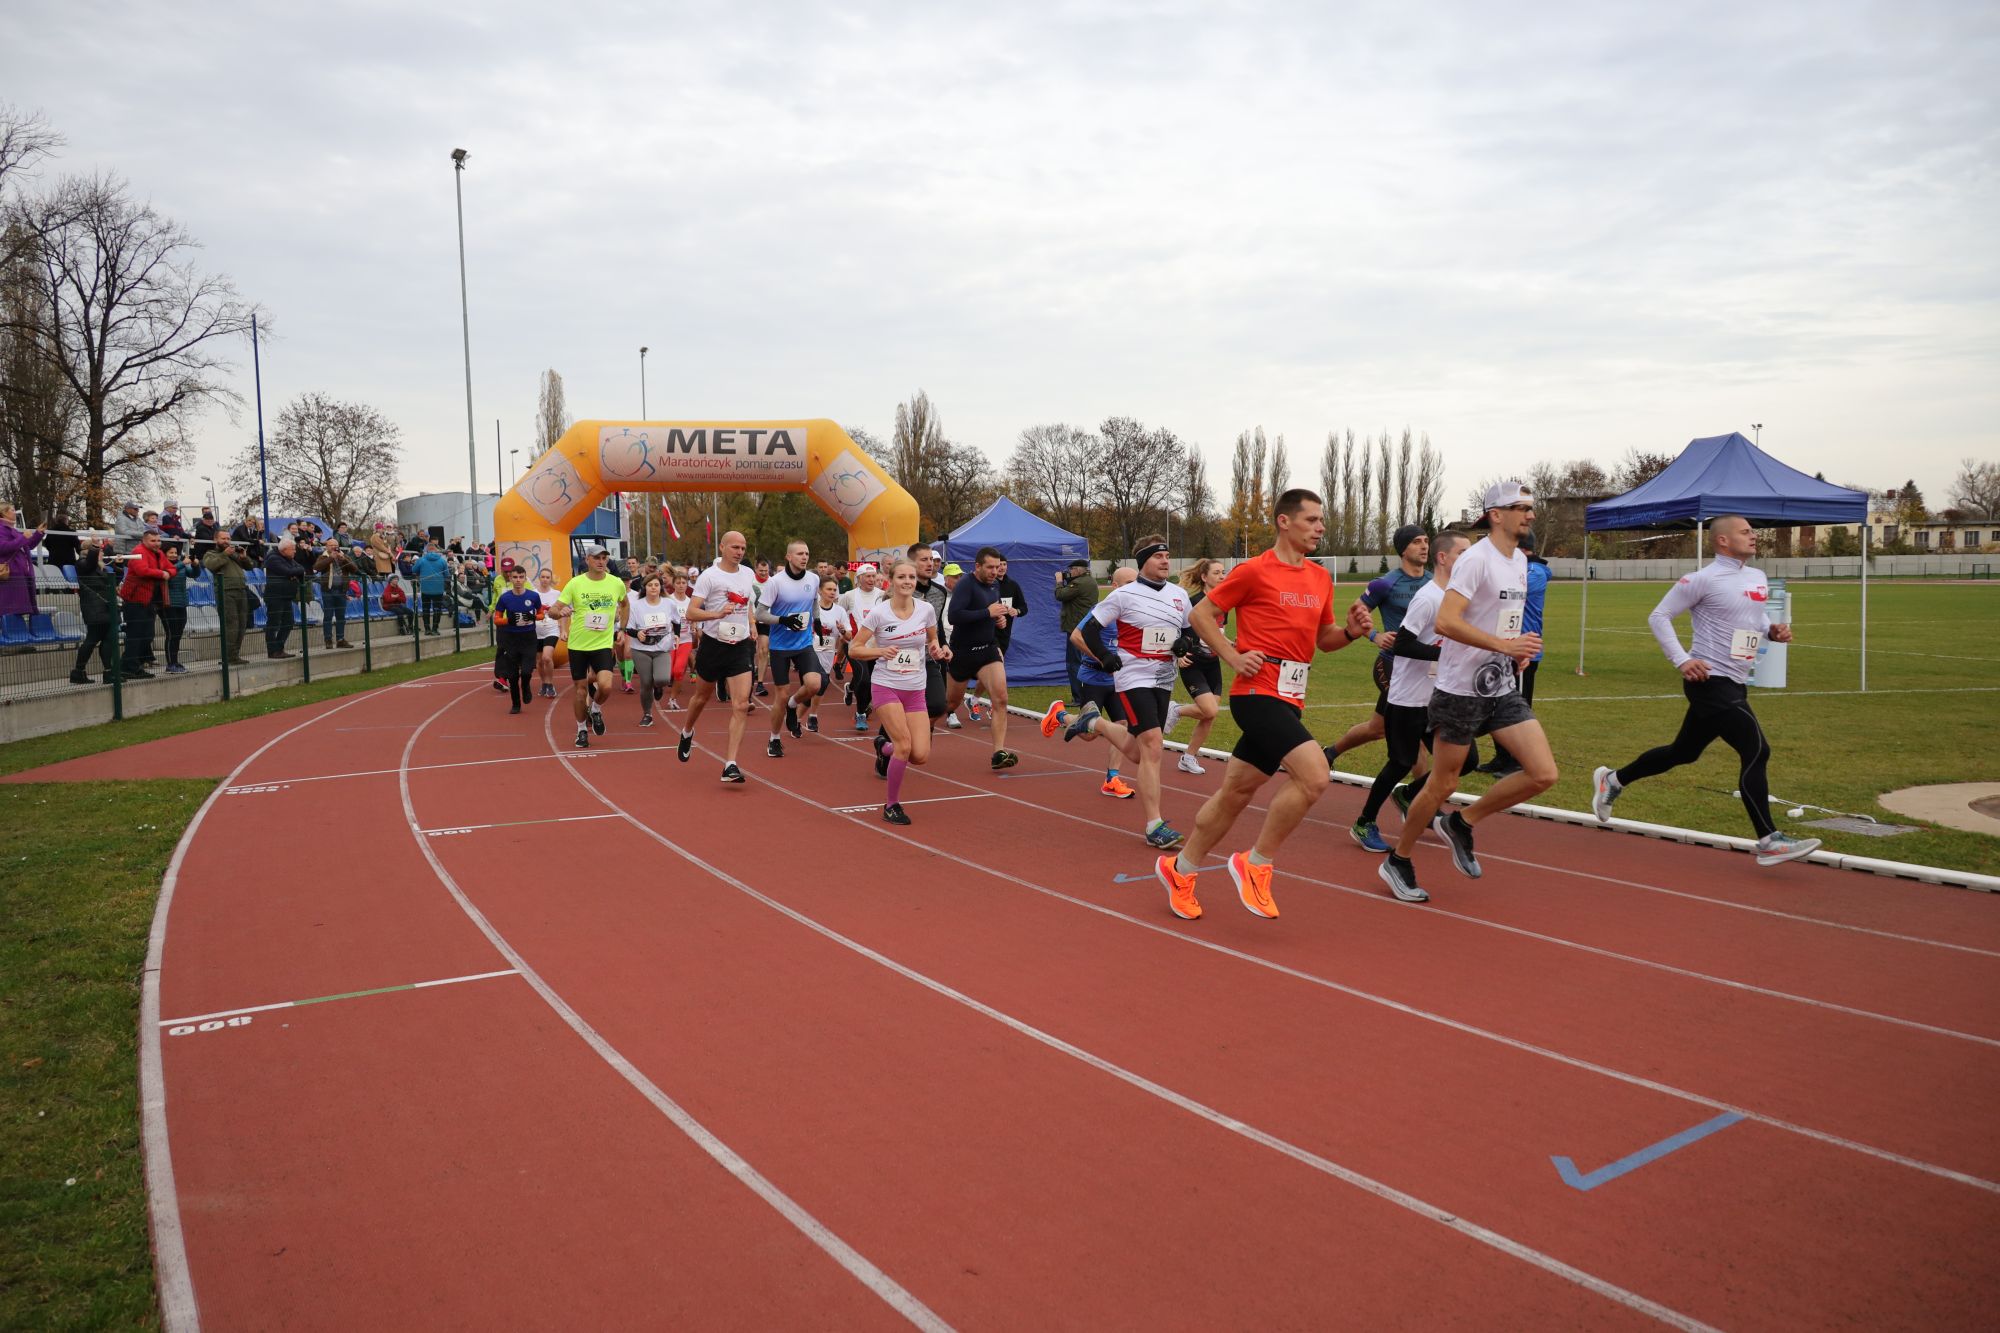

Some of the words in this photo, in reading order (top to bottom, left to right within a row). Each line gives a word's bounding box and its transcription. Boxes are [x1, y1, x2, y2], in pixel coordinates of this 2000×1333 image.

[667, 429, 797, 455] META
[659, 455, 732, 469] Maratończyk
[675, 472, 785, 481] www.maratonczykpomiarczasu.pl
[1279, 591, 1321, 609] RUN
[592, 615, 602, 623] 27
[1509, 615, 1520, 629] 57
[730, 626, 736, 636] 3
[884, 625, 897, 633] 4F
[1154, 632, 1166, 643] 14
[1746, 636, 1758, 648] 10
[898, 653, 911, 664] 64
[1291, 668, 1304, 683] 49
